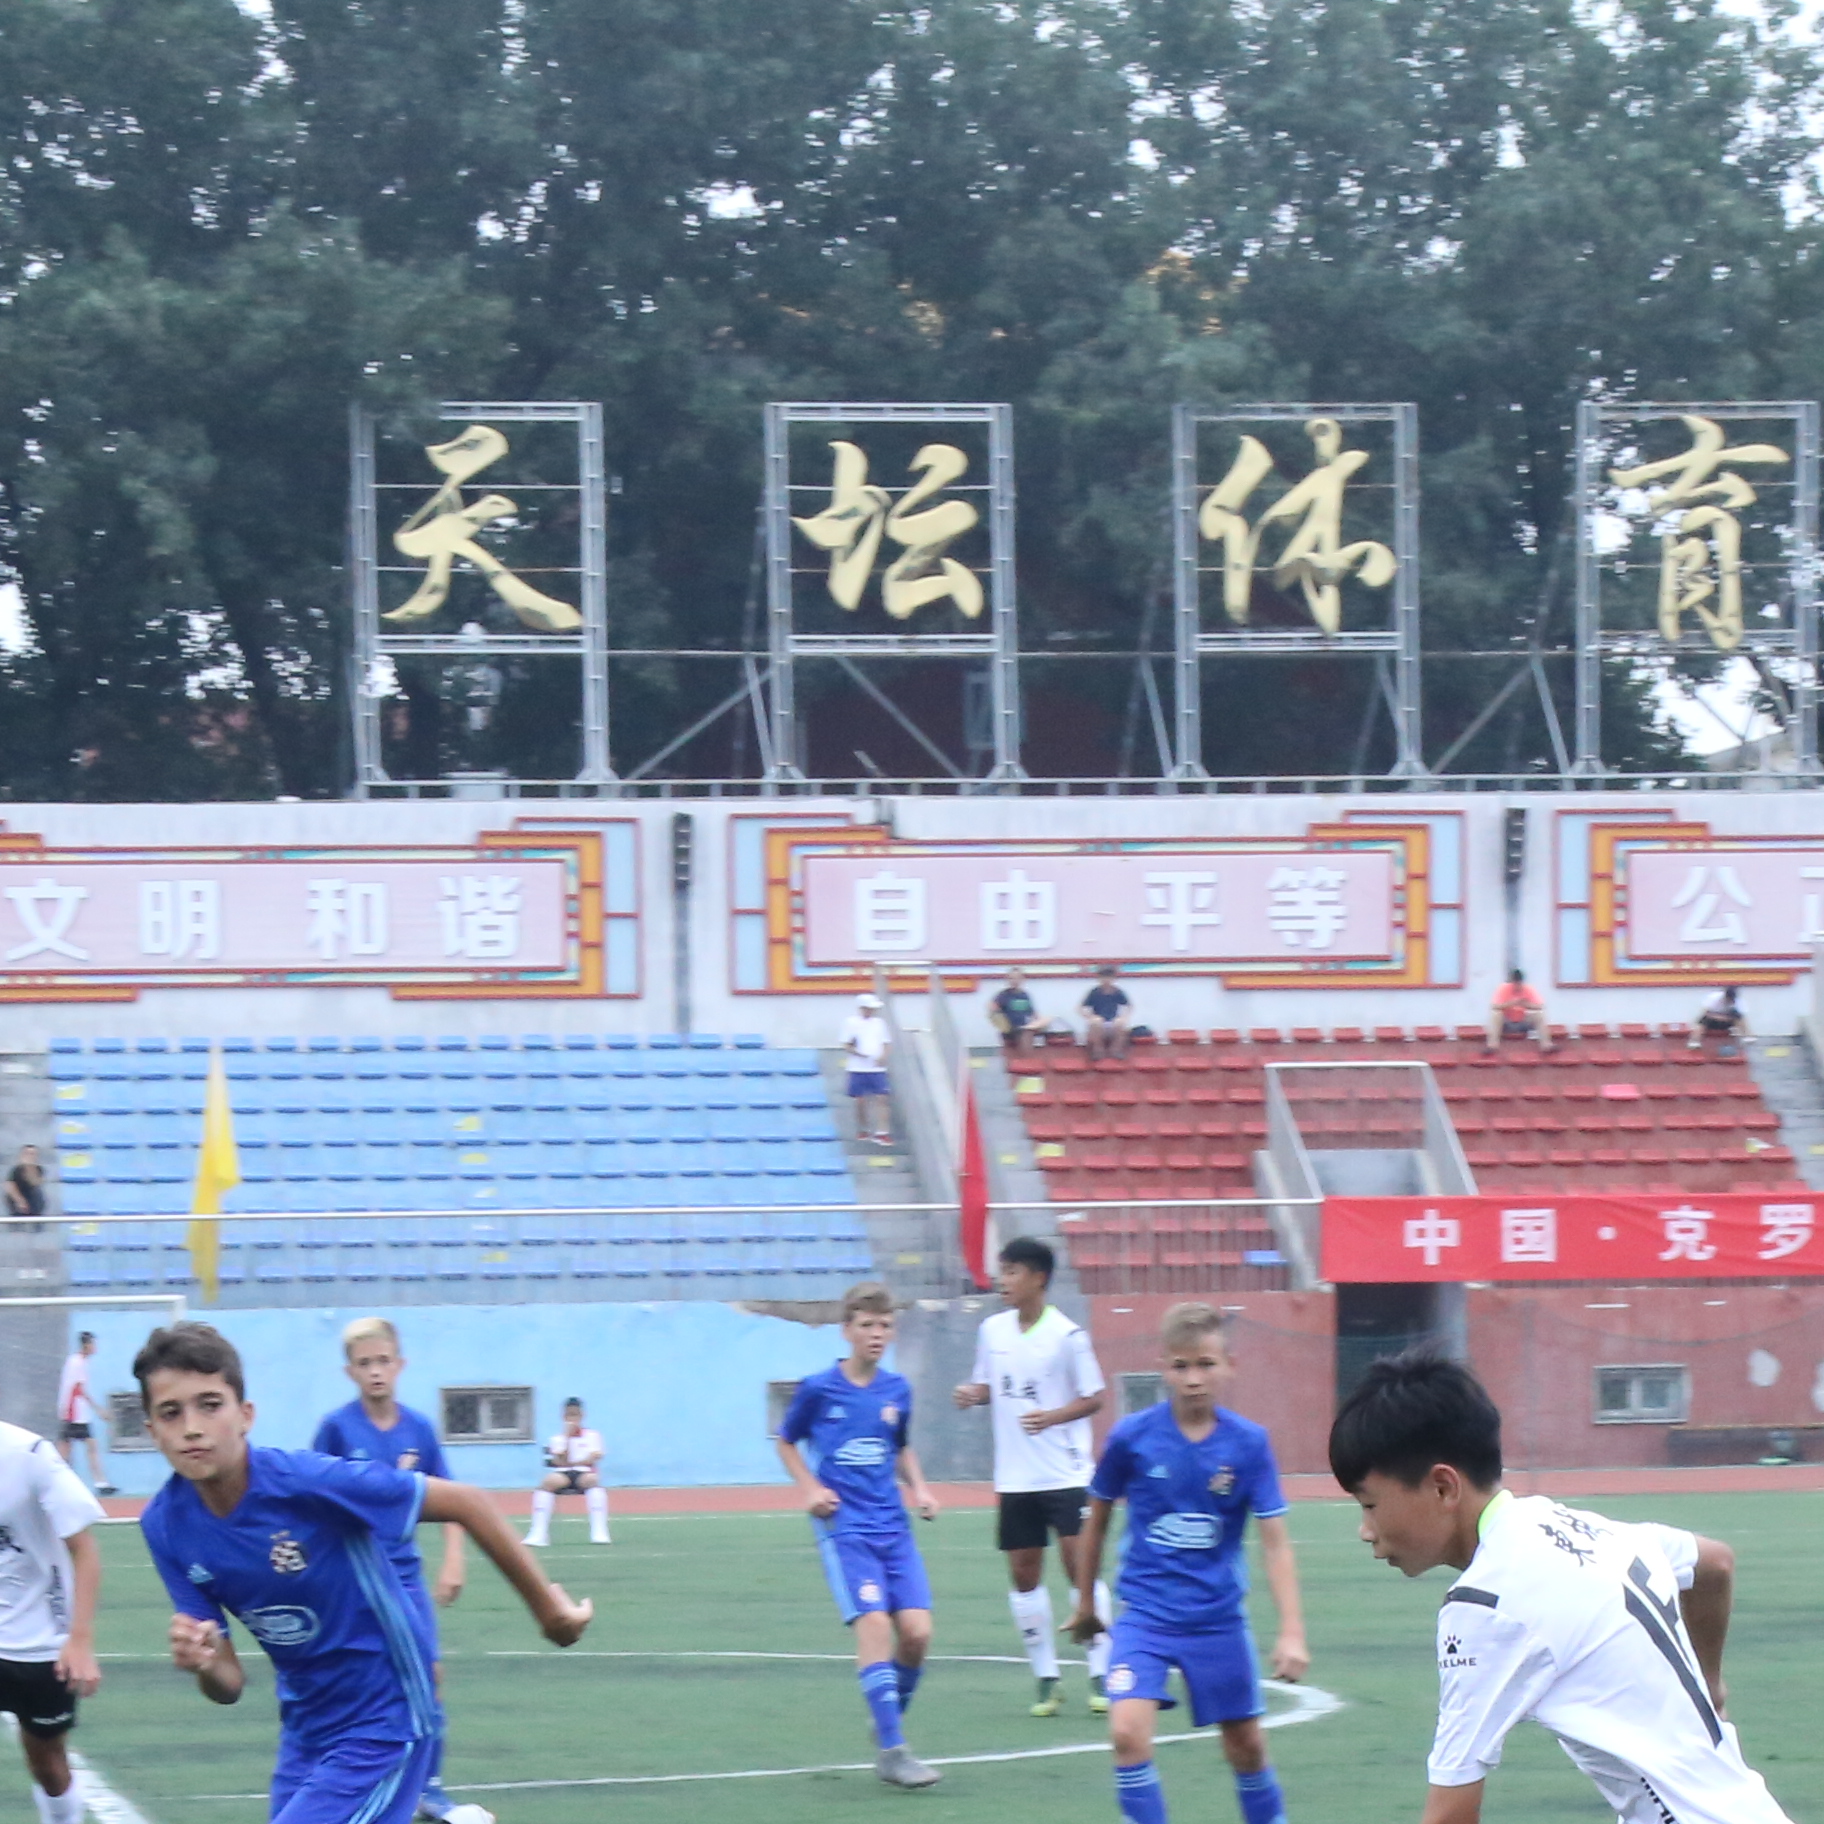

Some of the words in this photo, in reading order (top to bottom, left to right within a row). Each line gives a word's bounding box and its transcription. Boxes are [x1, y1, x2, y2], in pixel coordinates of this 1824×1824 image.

[3, 875, 524, 964] 文明和谐
[853, 866, 1349, 953] 自由平等
